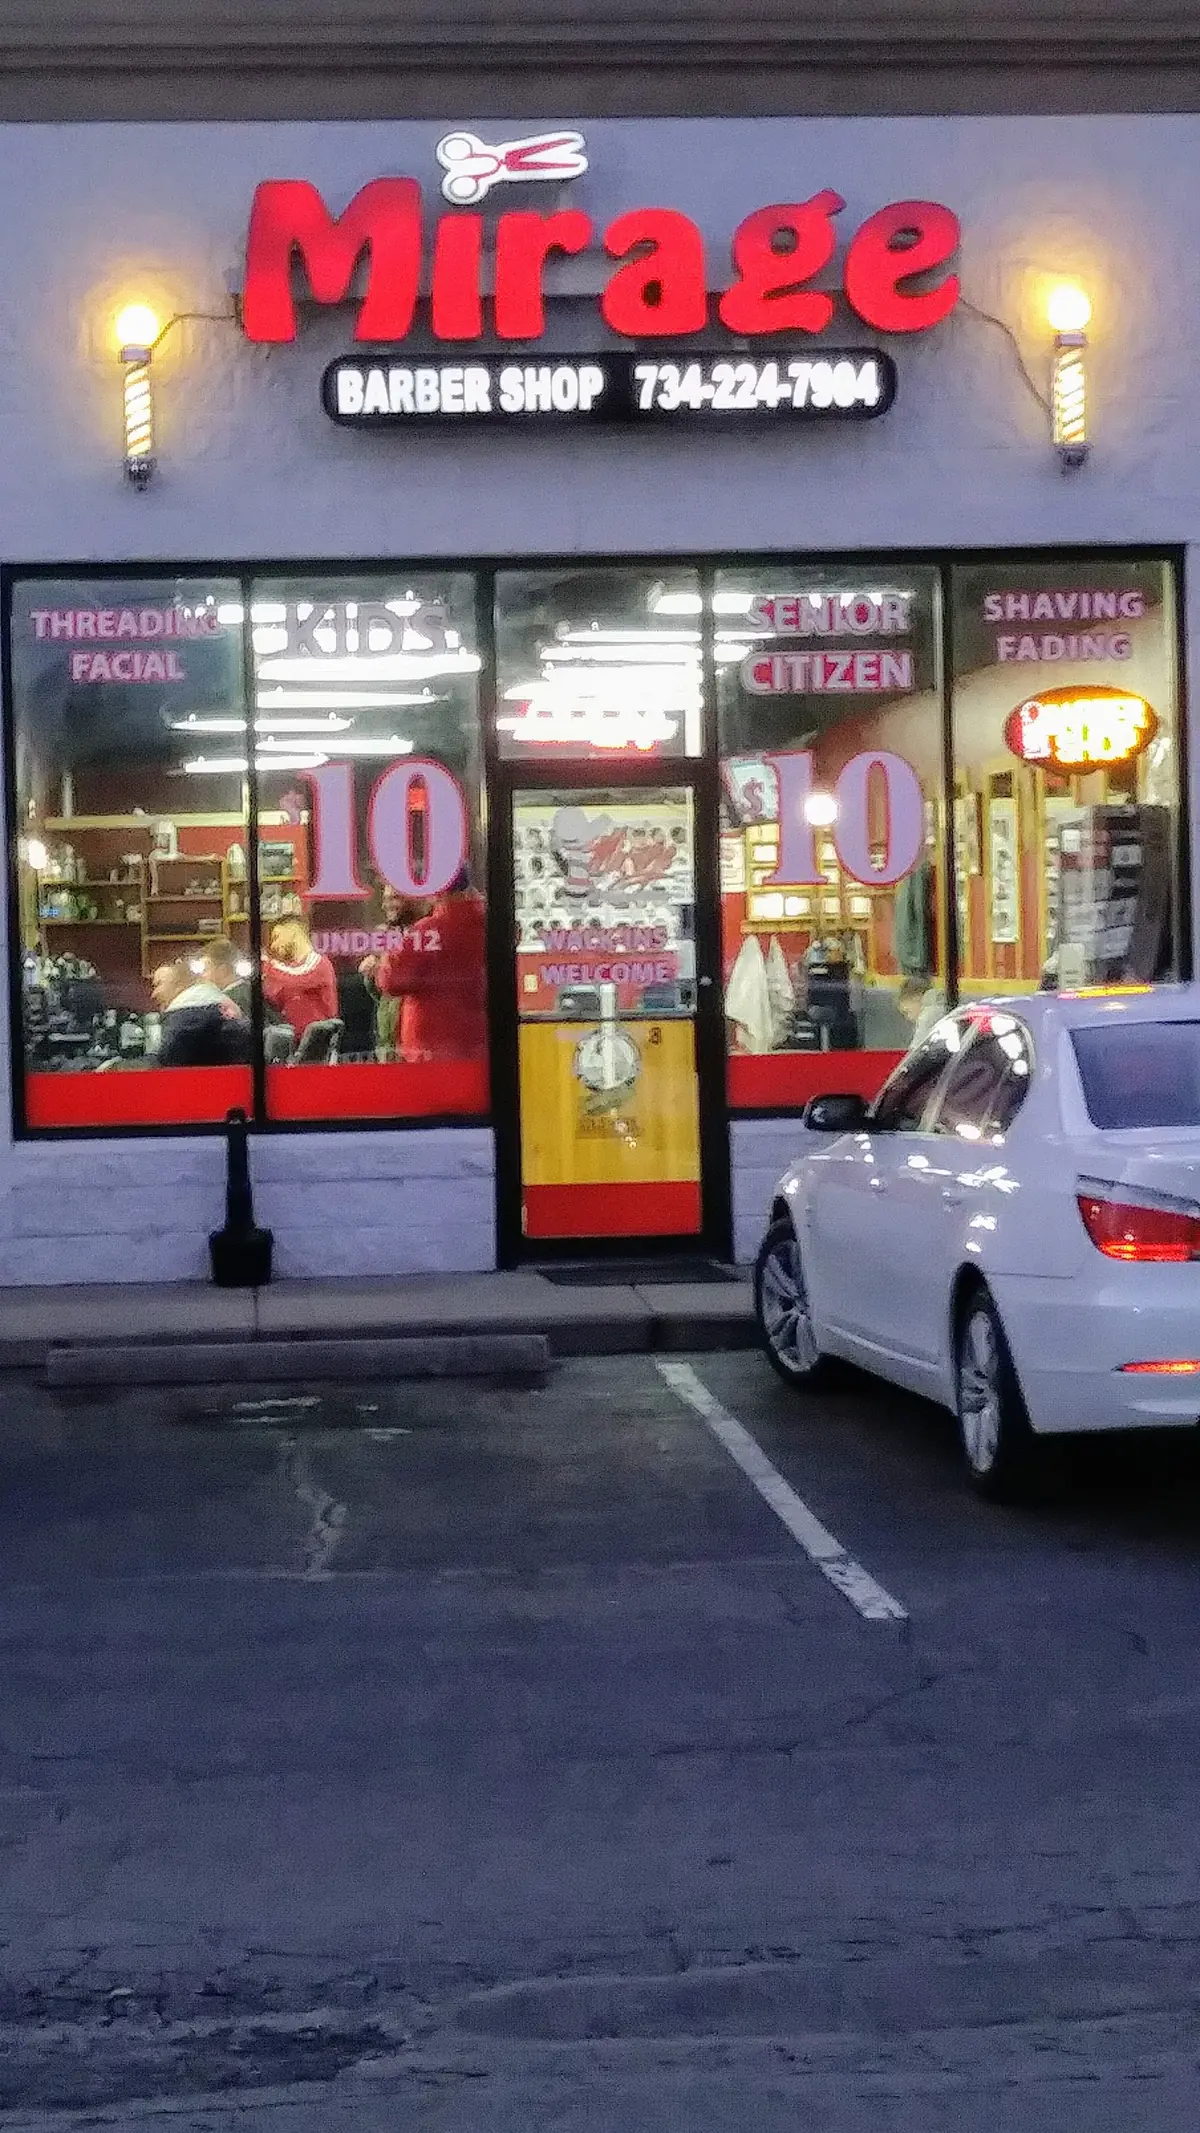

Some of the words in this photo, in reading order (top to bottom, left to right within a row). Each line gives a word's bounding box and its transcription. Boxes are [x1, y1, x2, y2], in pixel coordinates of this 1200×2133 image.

[243, 177, 961, 342] Mirage
[336, 368, 492, 414] BARBER
[499, 367, 605, 412] SHOP
[748, 593, 911, 633] SENIOR
[983, 591, 1144, 621] SHAVING
[30, 608, 220, 638] THREADING
[997, 633, 1133, 661] FADING
[70, 652, 185, 681] FACIAL
[742, 650, 913, 692] CITIZEN
[311, 930, 404, 954] UNDER
[407, 929, 442, 951] 12
[540, 961, 674, 985] WELCOME
